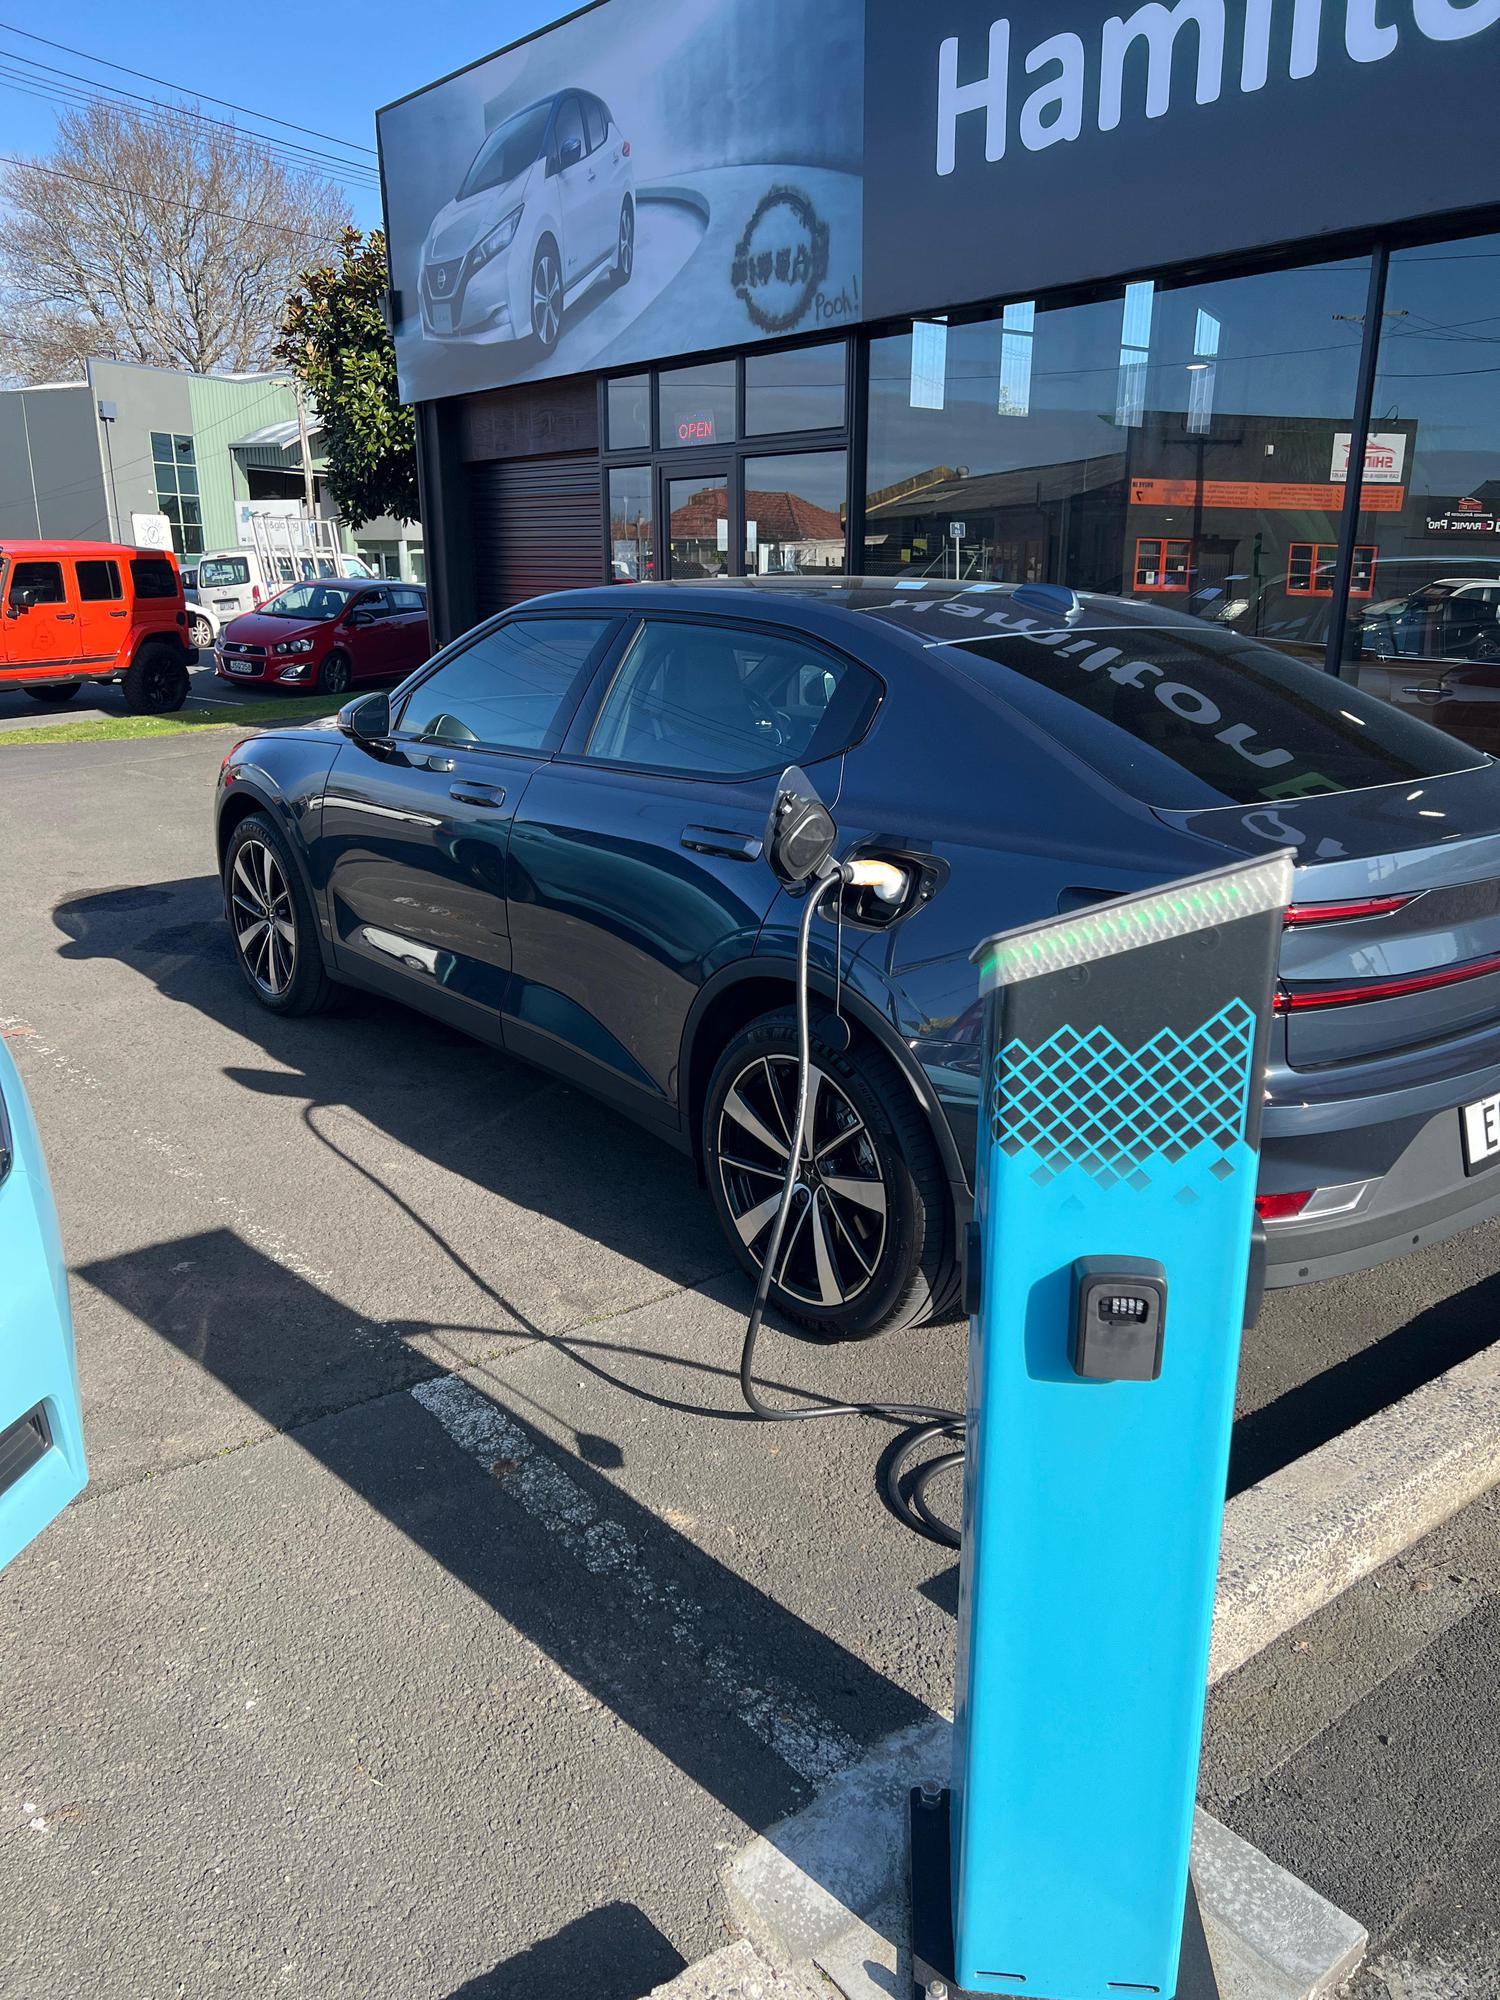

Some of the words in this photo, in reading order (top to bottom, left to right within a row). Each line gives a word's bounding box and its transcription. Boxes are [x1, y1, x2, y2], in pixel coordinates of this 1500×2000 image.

[815, 274, 859, 323] Pooh!
[678, 421, 712, 439] OPEN
[771, 1025, 852, 1077] MICELIN
[1483, 1096, 1500, 1150] E
